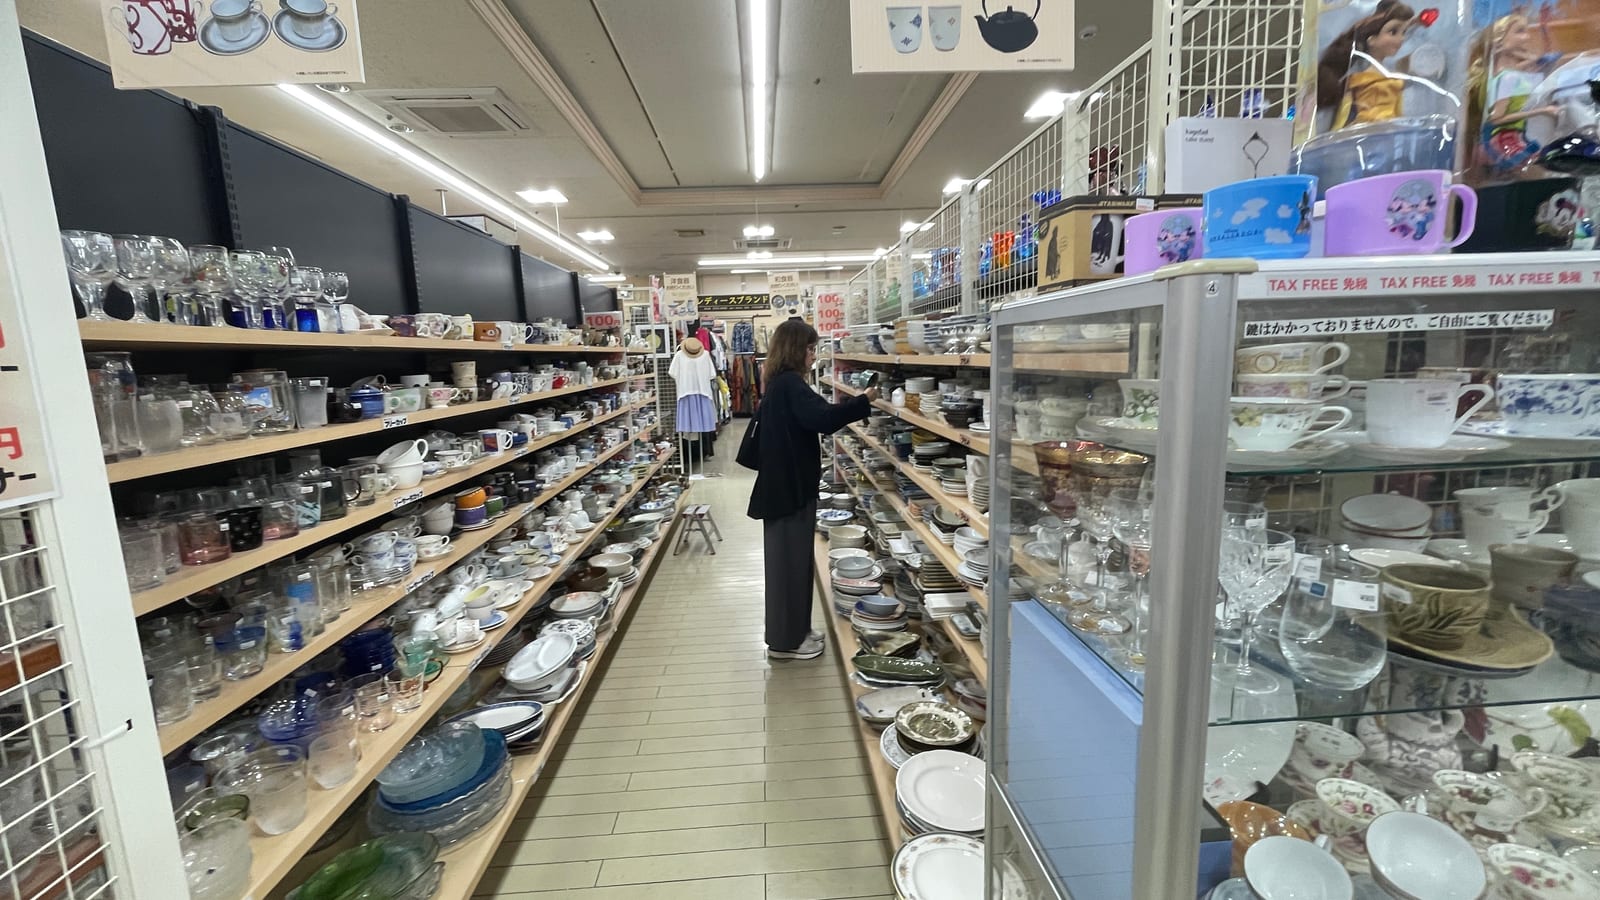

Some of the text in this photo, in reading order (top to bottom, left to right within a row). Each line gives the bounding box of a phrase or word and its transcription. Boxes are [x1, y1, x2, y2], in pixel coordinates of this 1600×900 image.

[1269, 277, 1368, 291] TAX FREE 免税
[1379, 274, 1476, 289] TAX FREE 免税
[1488, 271, 1582, 286] TAX FREE 免税
